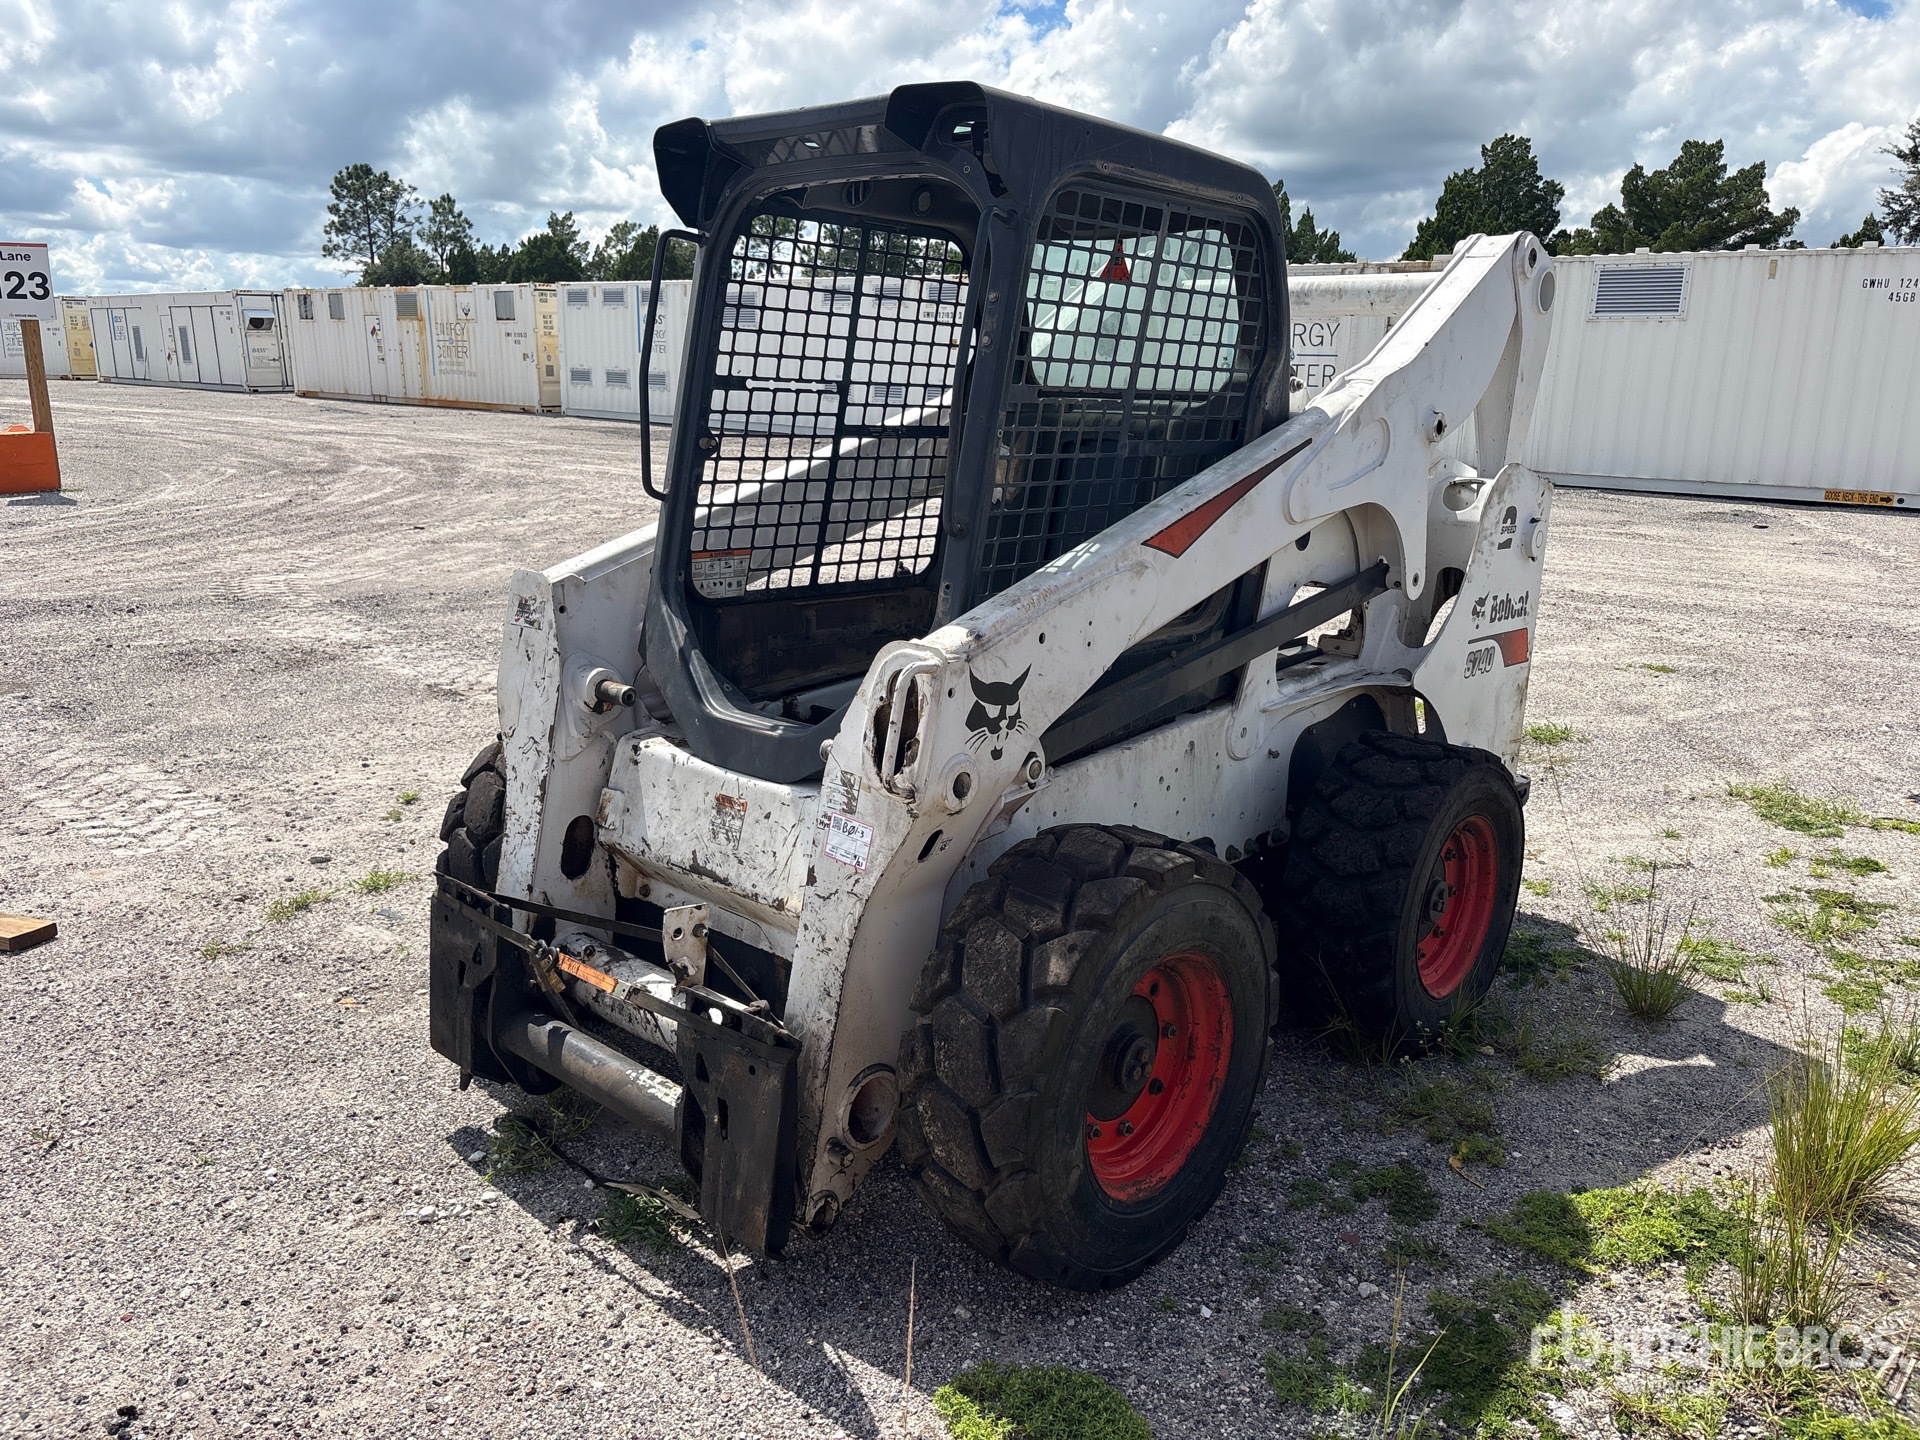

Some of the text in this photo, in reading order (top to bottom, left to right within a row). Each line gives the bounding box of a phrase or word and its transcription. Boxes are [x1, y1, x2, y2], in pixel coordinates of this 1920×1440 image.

[0, 251, 31, 261] Lane
[0, 271, 50, 300] 23
[1862, 278, 1890, 289] GWHU
[1888, 291, 1916, 303] 45GB
[1824, 490, 1841, 501] GOOSE
[1500, 525, 1518, 535] SPEED
[1463, 645, 1496, 679] S740
